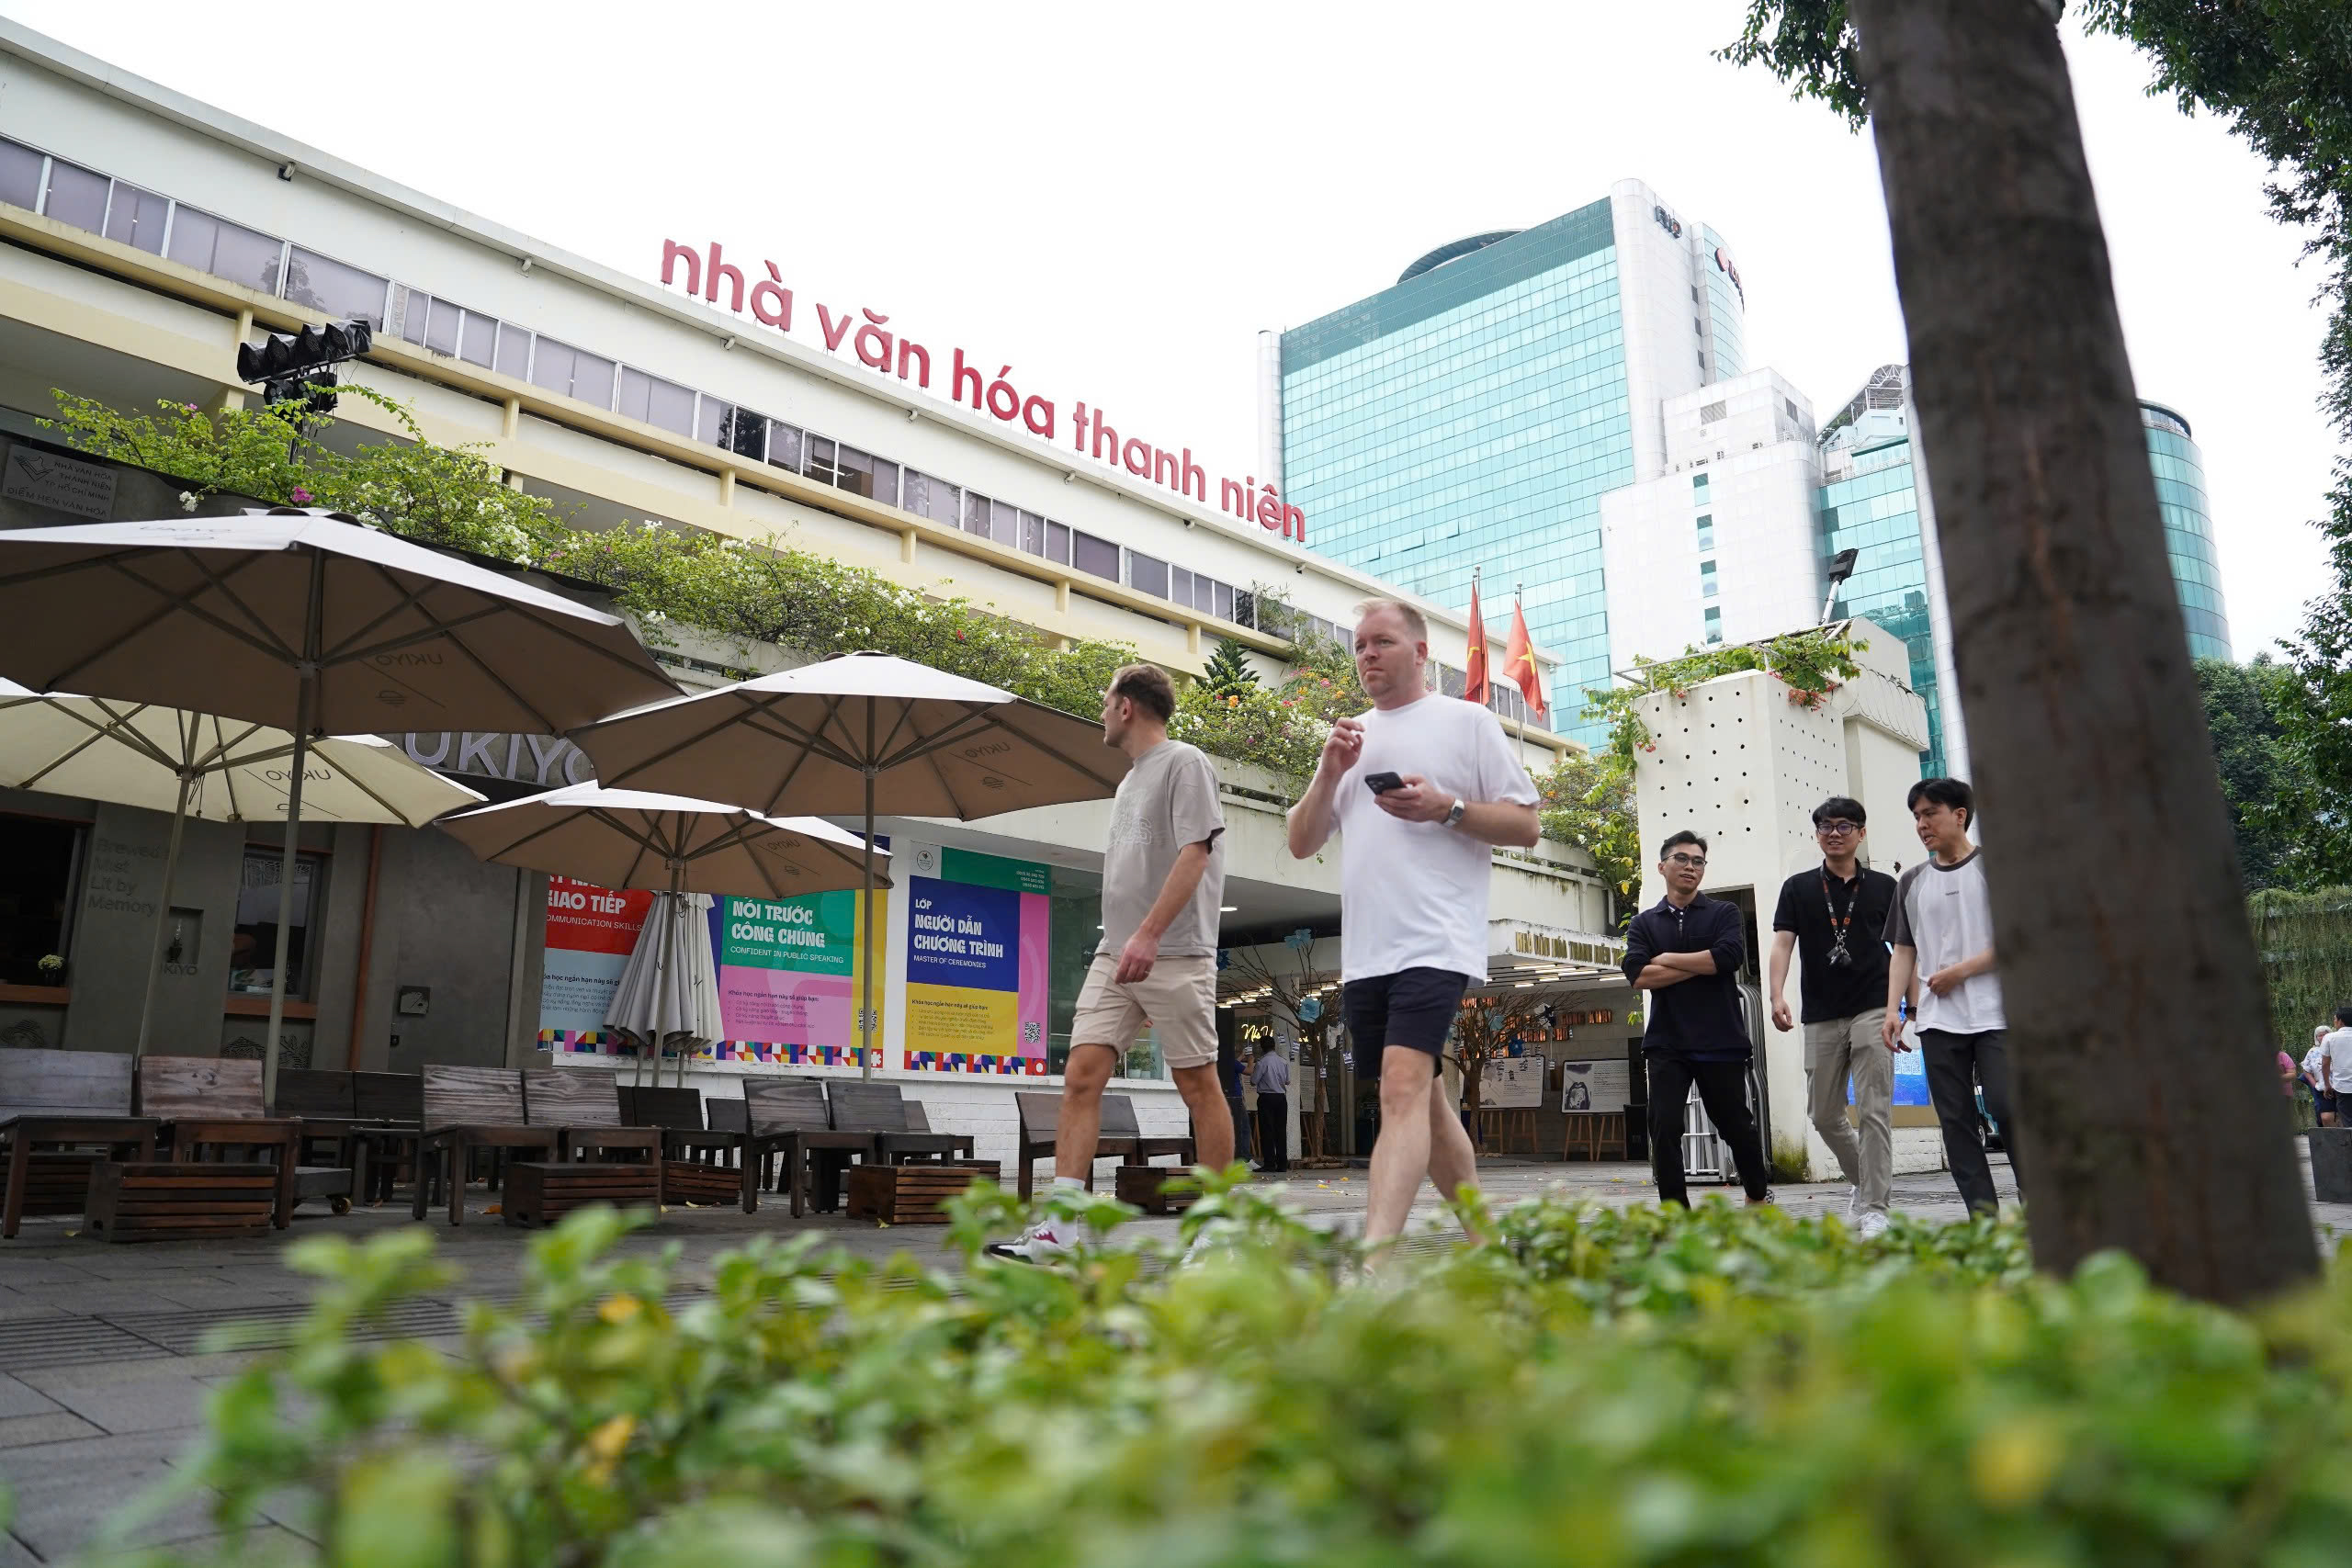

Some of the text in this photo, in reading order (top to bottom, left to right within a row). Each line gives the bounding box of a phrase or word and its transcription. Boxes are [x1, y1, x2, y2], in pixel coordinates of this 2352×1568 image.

[661, 238, 1306, 542] nhà văn hóa thanh niên
[60, 472, 89, 485] THANH
[88, 491, 110, 502] MINH
[117, 877, 139, 896] by
[88, 896, 155, 918] Memory
[590, 890, 627, 914] TIẾP
[915, 897, 933, 909] LỚP
[732, 899, 813, 926] NÓI TRƯỚC
[547, 915, 643, 931] OMMUNICATION SKILLS
[914, 914, 982, 936] NGƯỜI DẪN
[731, 920, 826, 948] CÔNG CHÚNG
[729, 946, 773, 957] CONFIDENT
[783, 952, 808, 961] PUBLIC
[809, 953, 844, 964] SPEAKING
[913, 934, 1003, 958] CHƯƠNG TRÌNH
[913, 954, 938, 964] MASTER
[948, 958, 987, 968] CEREMONIES
[581, 976, 593, 985] hạn
